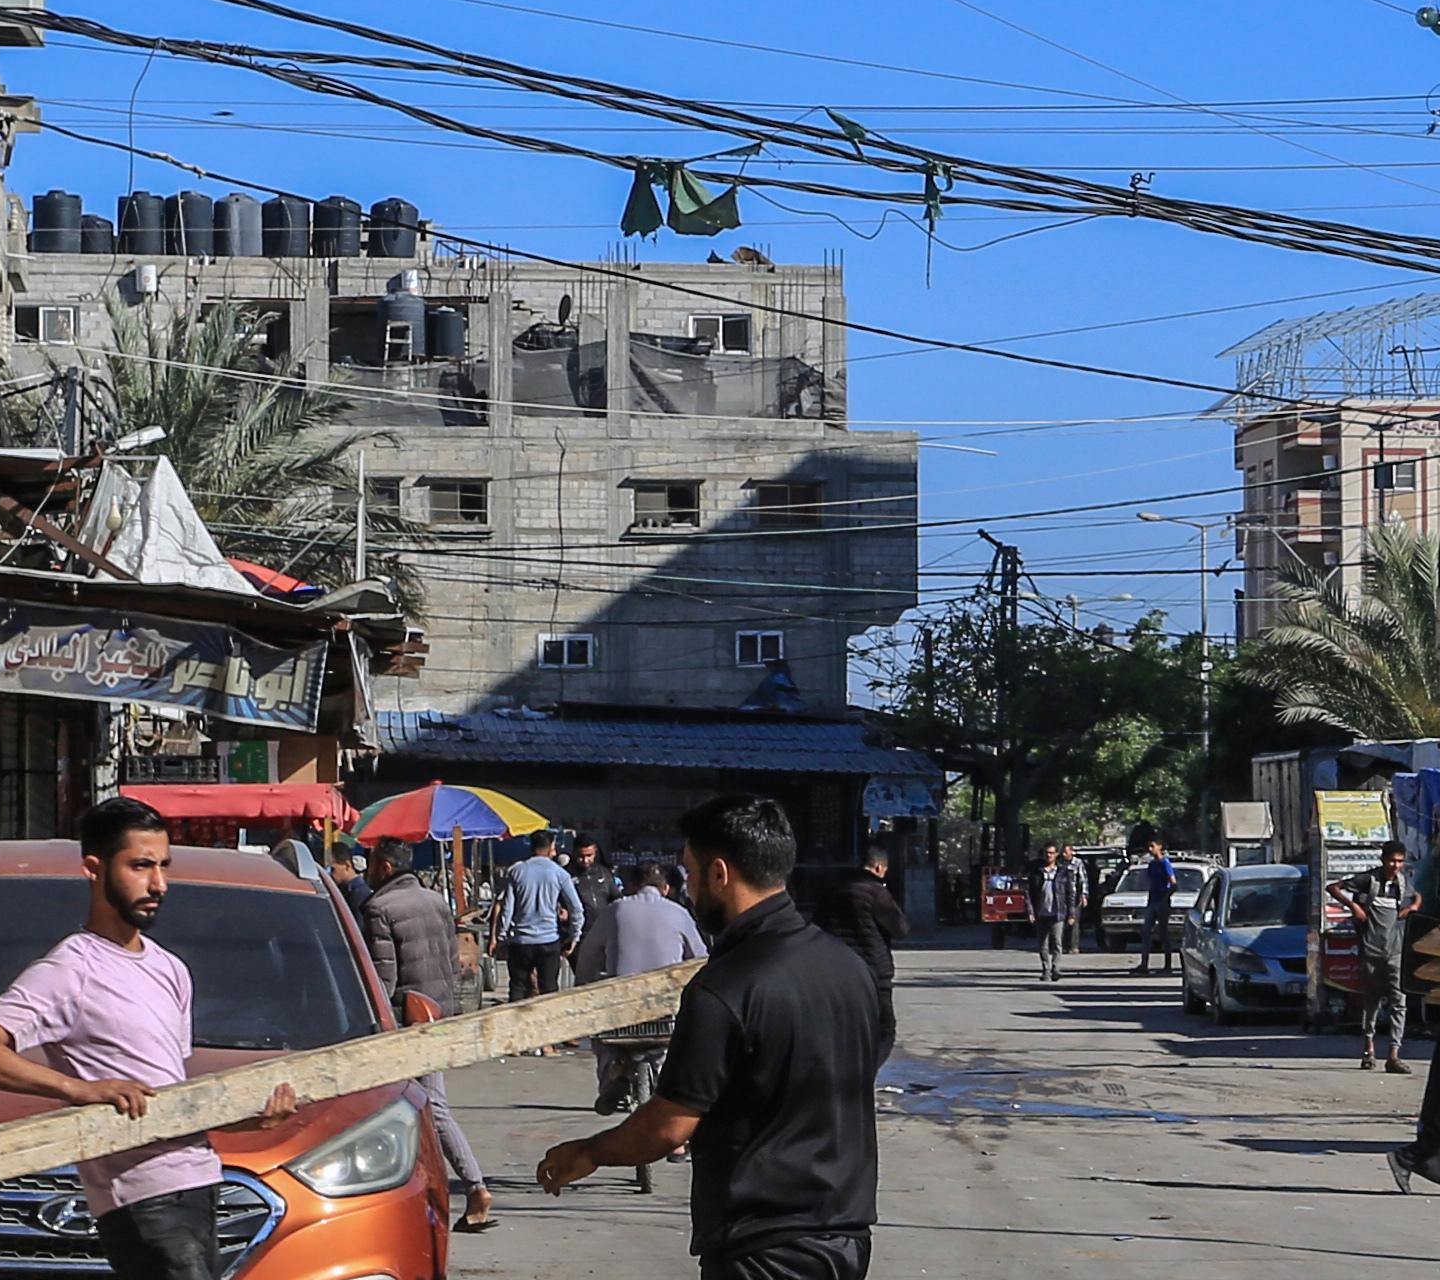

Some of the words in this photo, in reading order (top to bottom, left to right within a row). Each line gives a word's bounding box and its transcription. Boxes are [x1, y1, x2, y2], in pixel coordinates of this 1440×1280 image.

[85, 636, 168, 688] للخبز
[168, 641, 253, 698] ناصر
[255, 649, 308, 711] أبو
